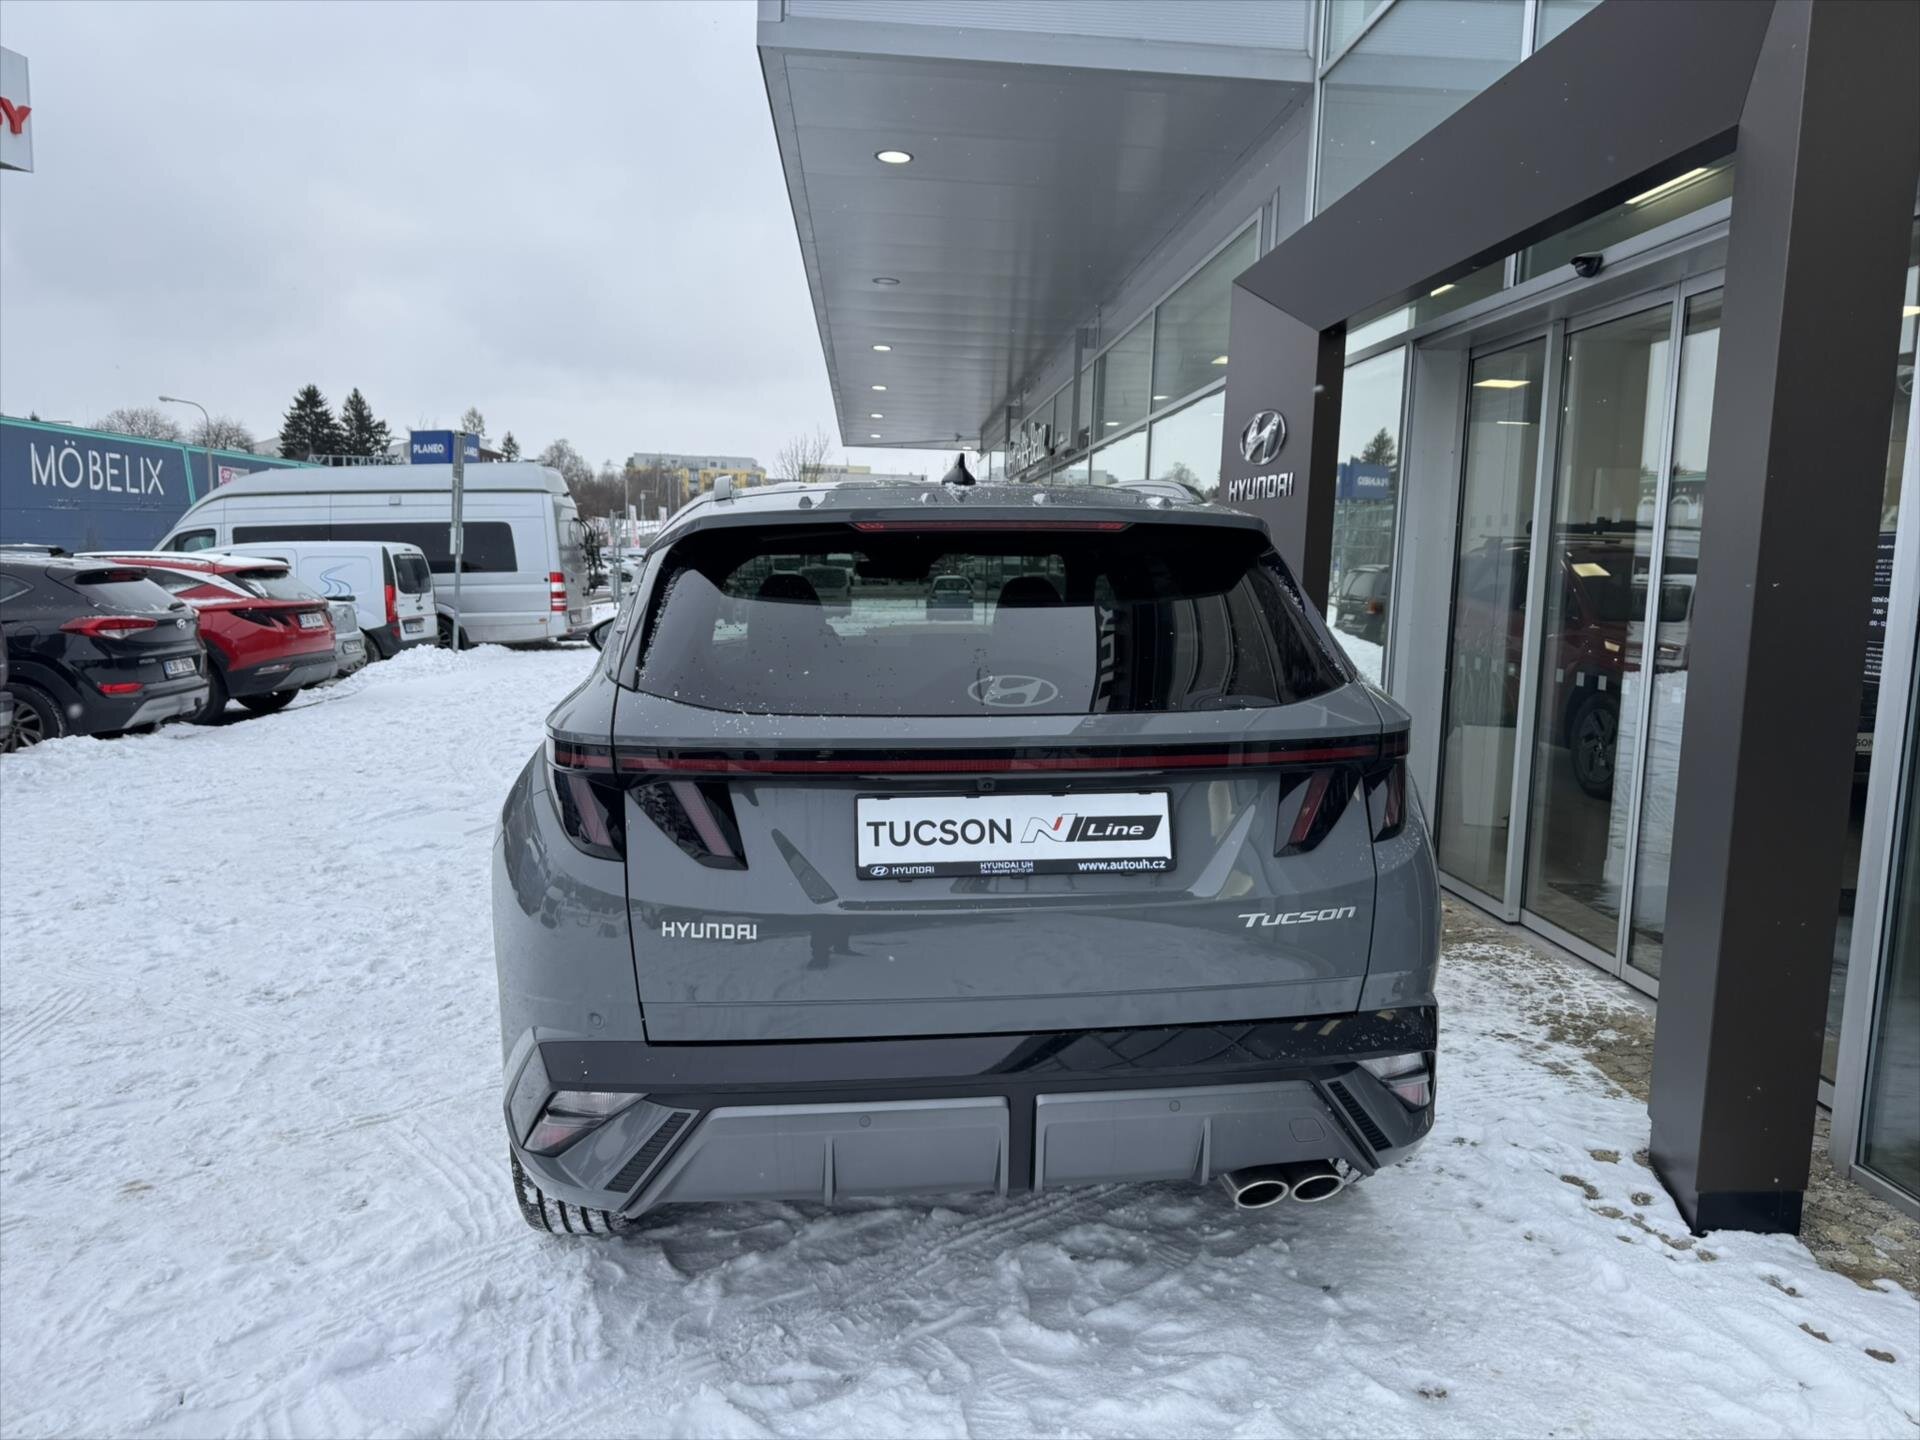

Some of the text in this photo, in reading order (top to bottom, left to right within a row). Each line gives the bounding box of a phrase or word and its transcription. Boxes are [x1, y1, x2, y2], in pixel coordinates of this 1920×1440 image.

[413, 443, 444, 454] PLANEO
[30, 439, 165, 496] MÖBELIX
[1228, 472, 1294, 502] HYUNDAI
[866, 818, 1013, 847] TUCSON
[1087, 822, 1145, 837] Line
[892, 866, 935, 875] HYUNDAI
[980, 860, 1034, 870] HYUNDAI UH
[1077, 859, 1167, 871] www.autouh.cz
[661, 921, 758, 940] HYUNDAI
